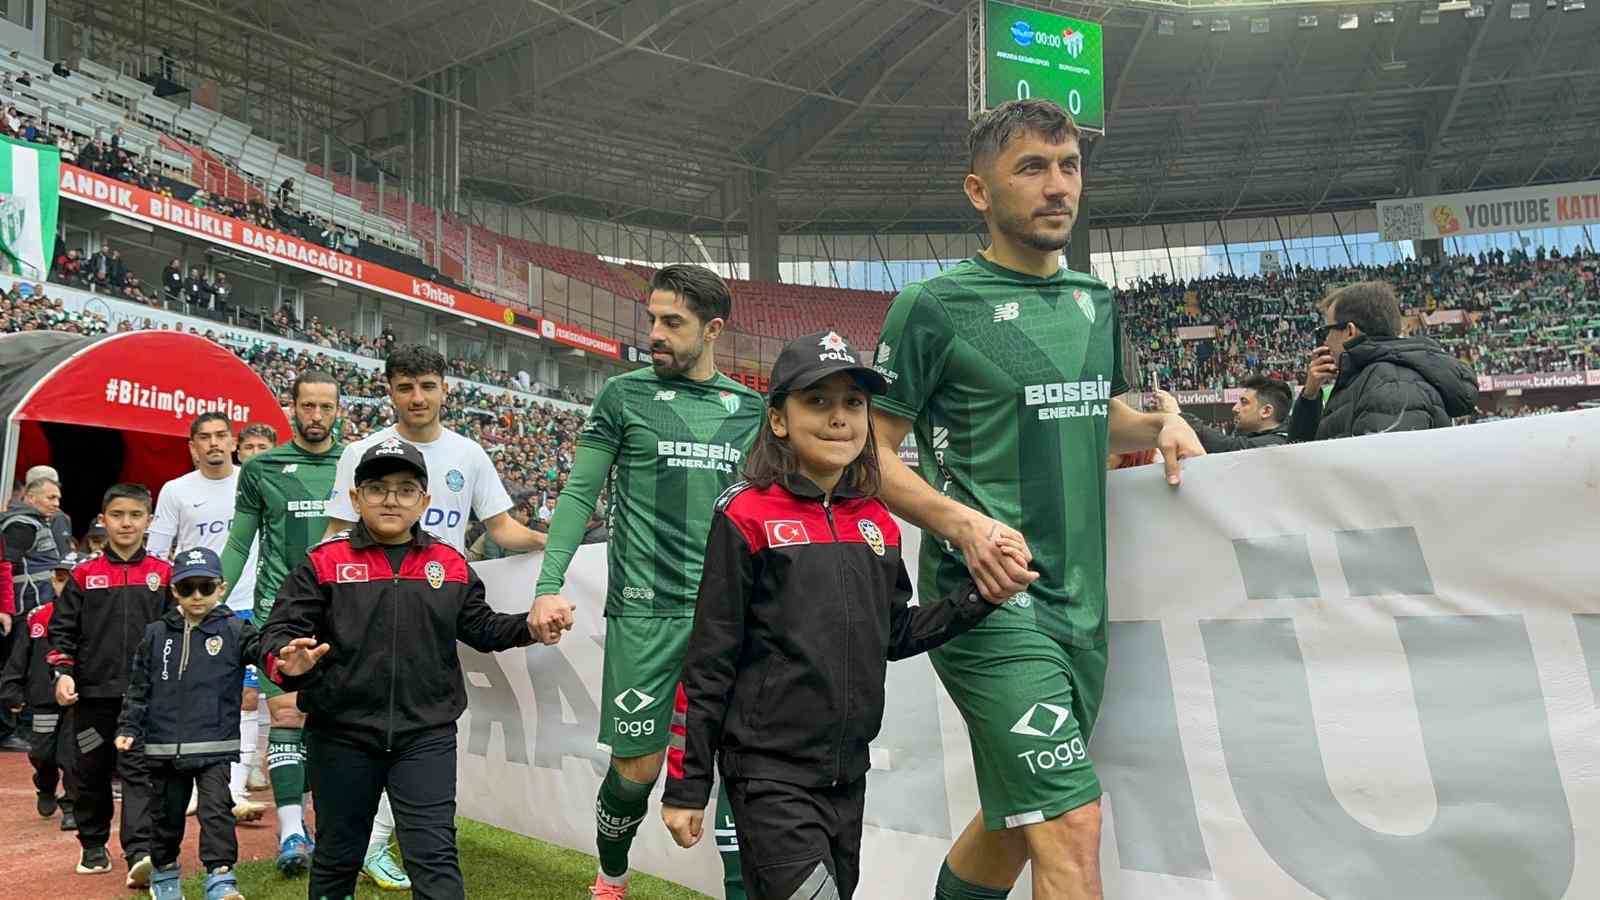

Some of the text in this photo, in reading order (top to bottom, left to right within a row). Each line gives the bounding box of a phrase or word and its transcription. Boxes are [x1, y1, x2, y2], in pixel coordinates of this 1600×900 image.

[1035, 31, 1061, 49] 00:00
[1069, 89, 1081, 115] 0
[1465, 199, 1551, 228] YOUTUBE
[150, 198, 233, 240] BİRLİKLE
[243, 226, 353, 276] BAŞARACAĞIZ
[613, 717, 655, 737] Togg
[1017, 737, 1087, 775] Togg
